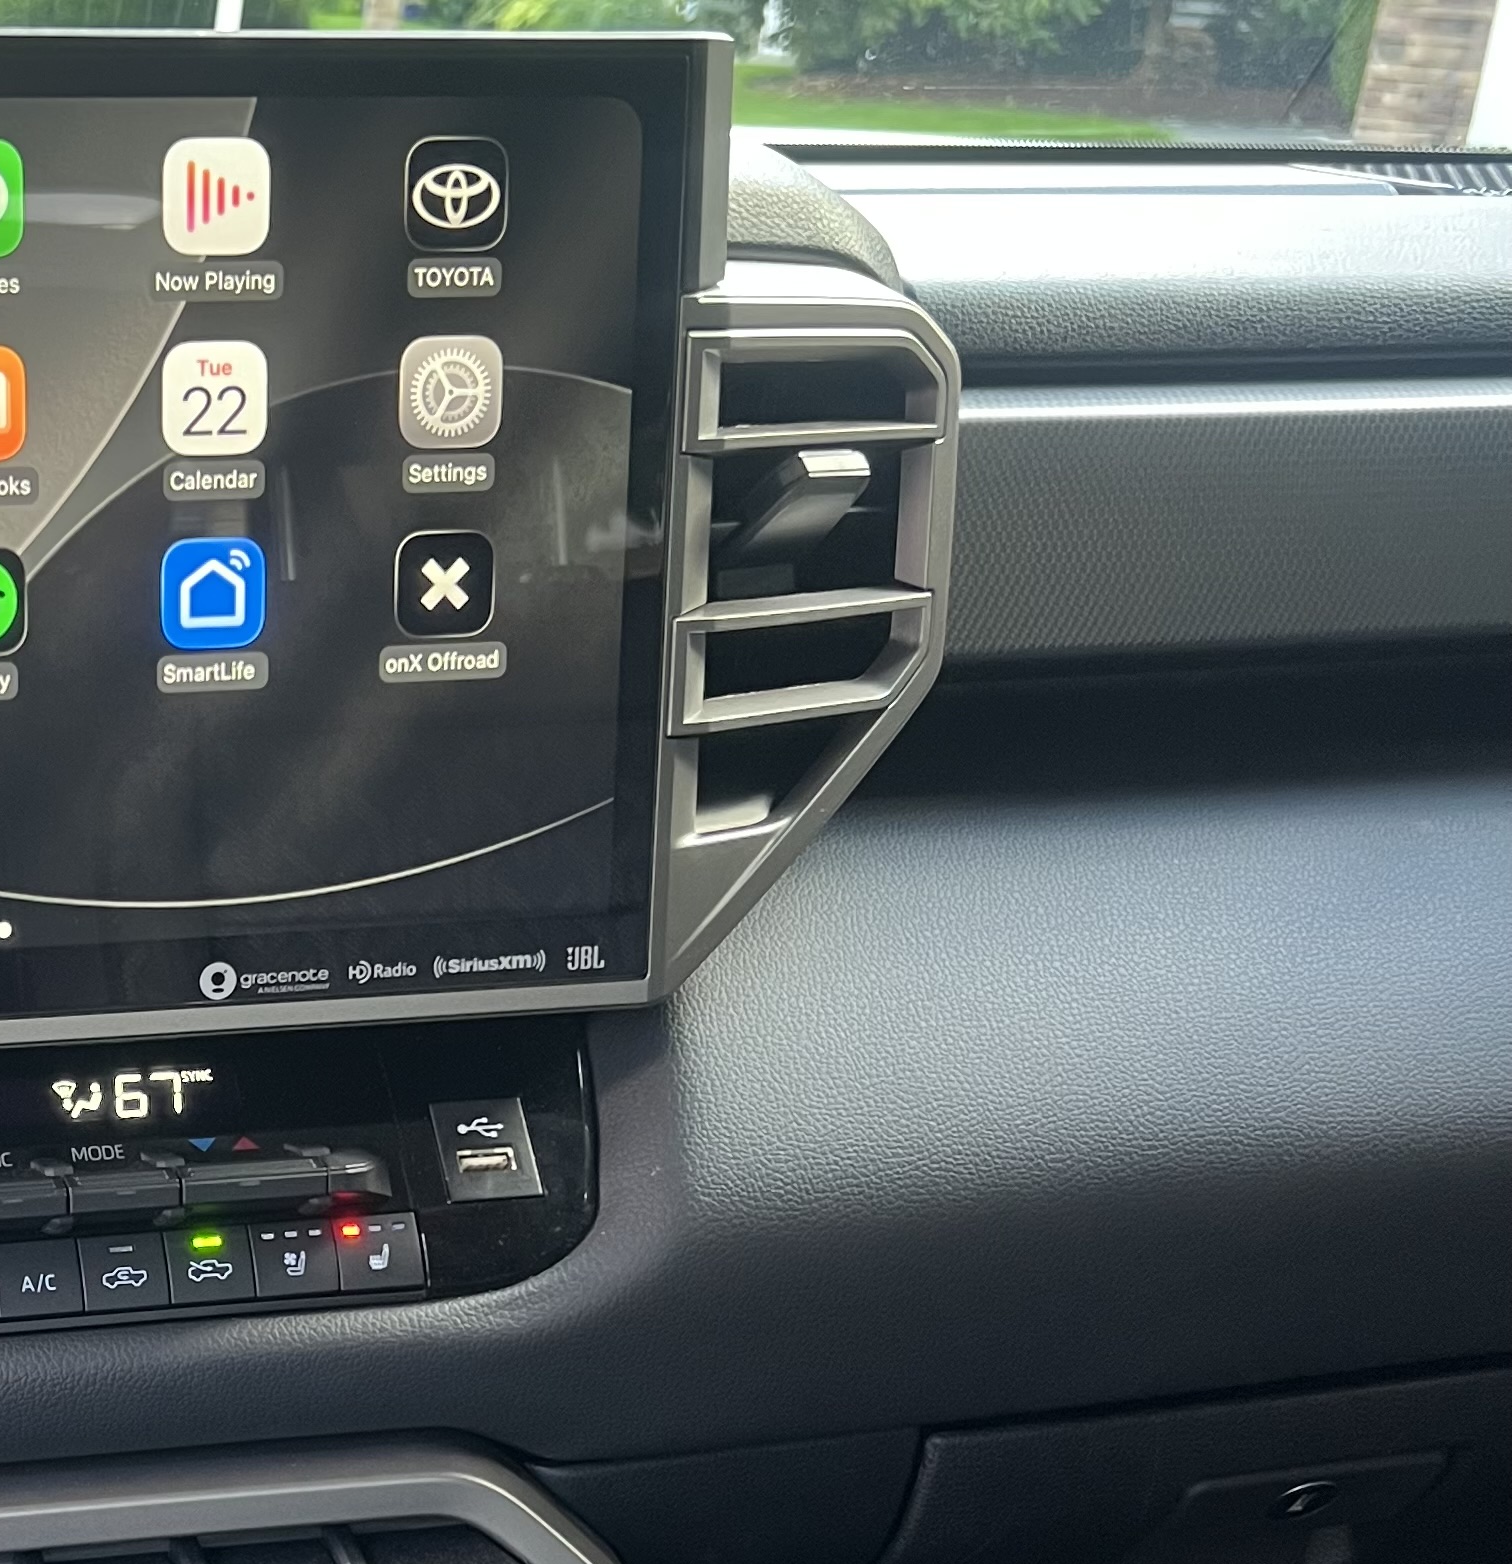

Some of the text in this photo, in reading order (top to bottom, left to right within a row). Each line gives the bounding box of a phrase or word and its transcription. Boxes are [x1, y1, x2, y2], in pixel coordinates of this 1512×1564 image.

[155, 270, 276, 298] Now Playing
[414, 265, 494, 290] TOYOTA
[197, 359, 232, 378] Tue
[181, 386, 248, 437] 22
[169, 468, 258, 492] Calendar
[408, 461, 488, 486] Settings
[162, 660, 256, 683] SmartLife
[384, 649, 500, 675] onX Offroad
[374, 962, 417, 979] Radio
[567, 946, 605, 971] JBL
[240, 967, 329, 989] gracenote
[181, 1068, 213, 1084] SYNC
[114, 1072, 184, 1119] 67
[70, 1143, 125, 1163] MODE
[21, 1272, 57, 1295] A/C
